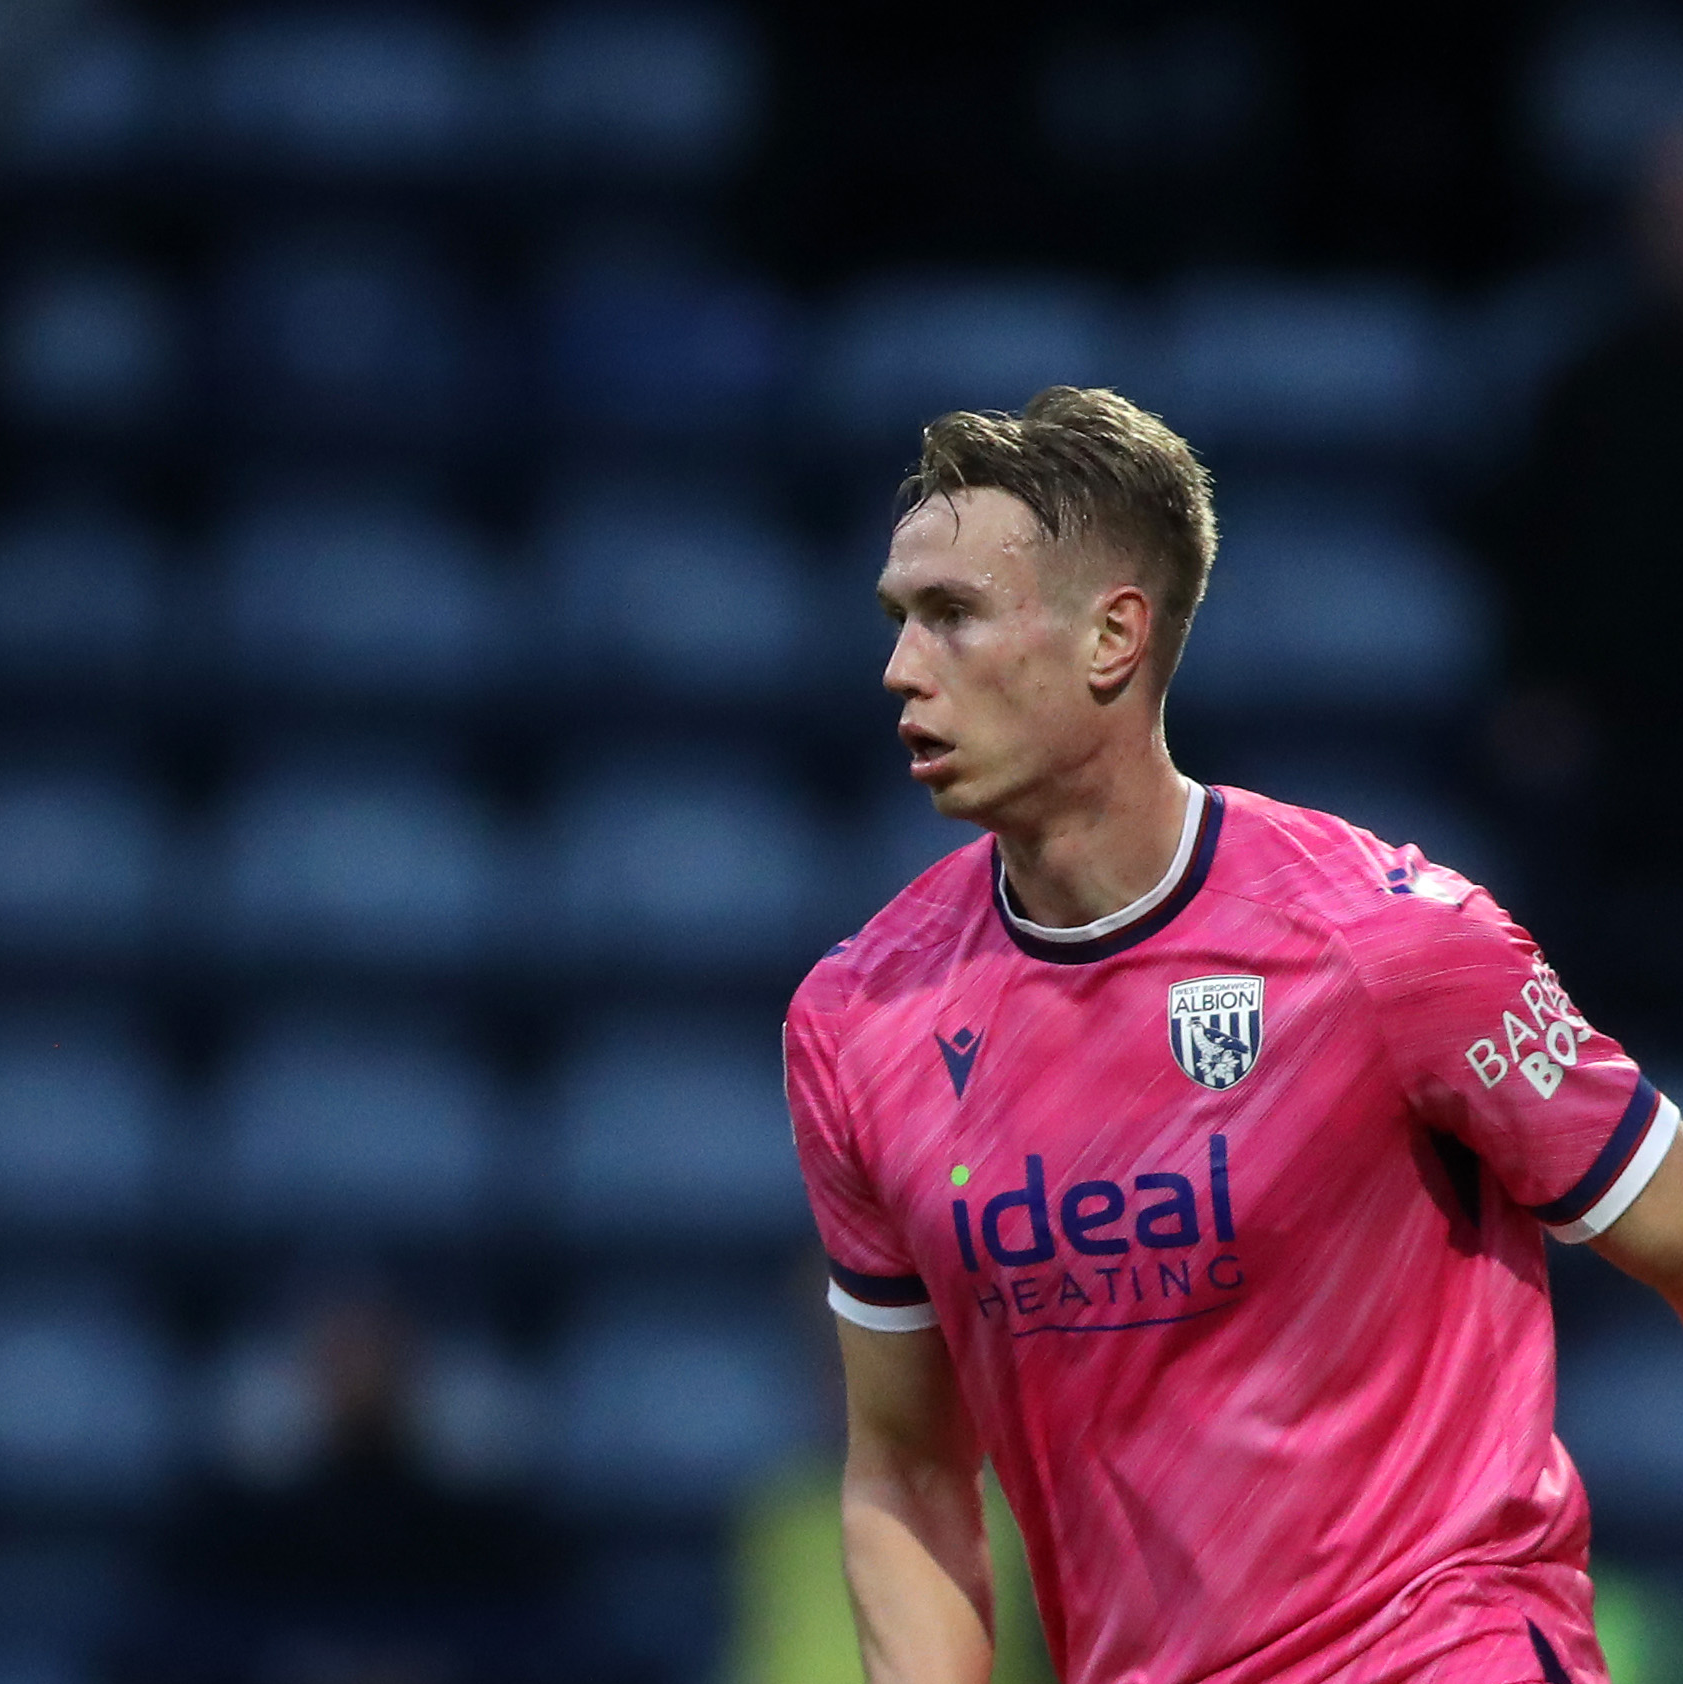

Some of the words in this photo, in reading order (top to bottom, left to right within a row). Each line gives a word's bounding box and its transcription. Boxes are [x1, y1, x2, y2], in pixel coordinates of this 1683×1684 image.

[1175, 986, 1200, 995] WEST
[1203, 982, 1256, 993] BROMWICH
[1175, 991, 1254, 1013] ALBION
[950, 1134, 1234, 1272] ideal
[972, 1254, 1245, 1319] HEATING
